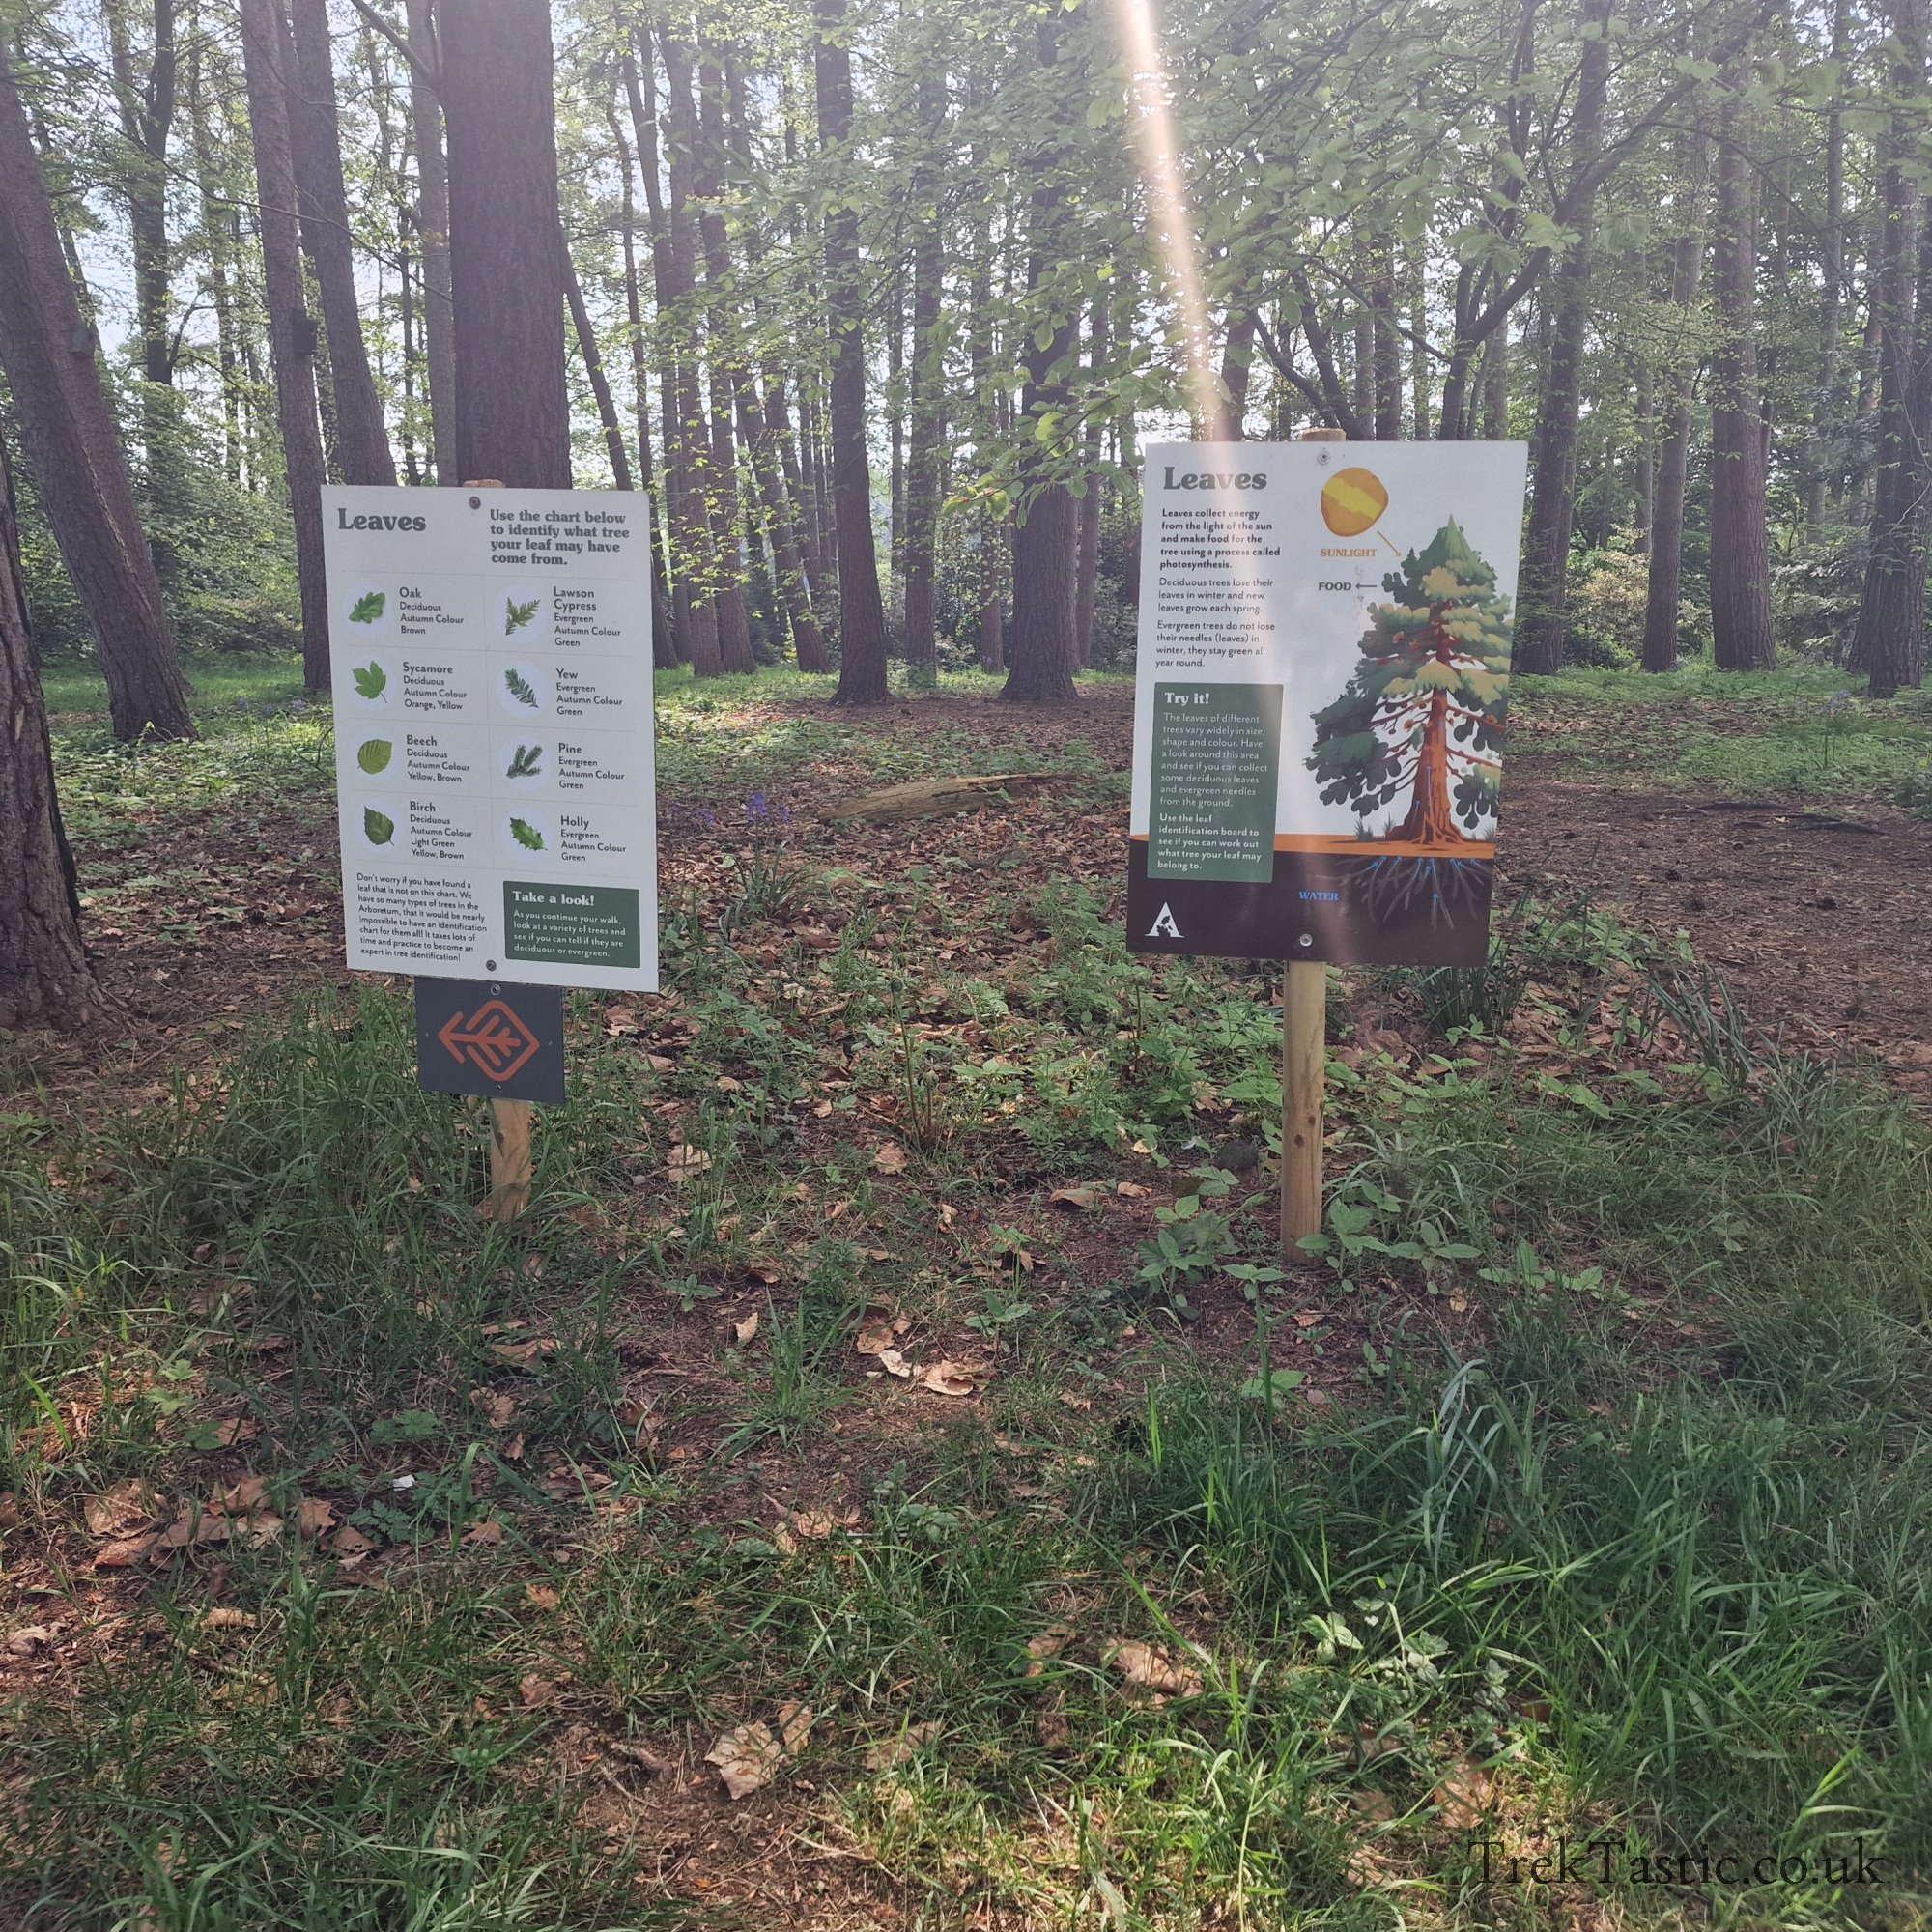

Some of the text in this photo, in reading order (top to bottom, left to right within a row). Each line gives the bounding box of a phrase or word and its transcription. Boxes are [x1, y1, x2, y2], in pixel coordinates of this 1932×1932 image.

[1163, 467, 1267, 490] Leaves
[337, 508, 426, 531] Leaves
[490, 509, 626, 524] Use the chart below
[1162, 508, 1260, 521] Leaves collect energy
[490, 524, 629, 540] to identify what tree
[491, 538, 620, 554] your leaf may have
[1180, 547, 1206, 558] using
[1215, 550, 1250, 558] process
[1252, 547, 1280, 555] called
[1321, 549, 1377, 557] SUNLIGHT
[491, 553, 567, 565] come from.
[1159, 559, 1232, 571] photosynthesis.
[1159, 577, 1207, 586] Deciduous
[1233, 578, 1250, 586] lose
[1253, 578, 1273, 587] their
[1319, 582, 1351, 591] FOOD
[399, 586, 421, 598] Oak
[554, 585, 594, 598] Lawson
[1159, 590, 1184, 599] leaves
[1227, 590, 1244, 599] and
[400, 601, 441, 611] Deciduous
[554, 598, 597, 612] Cypress
[400, 613, 464, 623] Autumn Colour
[554, 612, 593, 624] Evergreen
[401, 625, 426, 634] Brown
[554, 625, 621, 636] Autumn Colour
[1157, 620, 1200, 632] Evergreen
[1226, 621, 1237, 630] do
[554, 638, 580, 646] Green
[1157, 633, 1177, 641] their
[1179, 633, 1212, 641] needles
[1215, 633, 1248, 643] (leaves)
[403, 661, 453, 675] Sycamore
[1155, 658, 1205, 668] year round.
[555, 668, 578, 679] Yew
[403, 675, 444, 686] Deciduous
[404, 687, 467, 697] Autumn Colour
[556, 682, 595, 694] Evergreen
[404, 698, 463, 710] Orange, Yellow
[556, 695, 622, 705] Autumn Colour
[1165, 692, 1209, 706] Try it!
[556, 705, 582, 716] Green
[1163, 712, 1260, 723] The leaves of different
[407, 734, 437, 746] Beech
[407, 748, 448, 758] Deciduous
[558, 742, 582, 753] Pine
[408, 759, 469, 771] Autumn Colour
[558, 756, 597, 768] Evergreen
[408, 771, 462, 782] Yellow, Brown
[558, 768, 624, 780] Autumn Colour
[1186, 773, 1231, 782] deciduous
[1234, 774, 1259, 783] leaves
[559, 780, 583, 789] Green
[1160, 784, 1256, 796] and evergreen needles
[410, 801, 436, 812] Birch
[1160, 796, 1232, 809] from the ground.
[410, 813, 450, 825] Deciduous
[560, 815, 589, 830] Holly
[1159, 812, 1212, 823] Use the leaf
[411, 826, 472, 838] Autumn Colour
[560, 829, 599, 840] Evergreen
[1159, 825, 1218, 835] identification
[1221, 827, 1247, 836] board
[411, 837, 455, 847] Light Green
[561, 840, 626, 852] Autumn Colour
[411, 848, 464, 859] Yellow, Brown
[561, 852, 585, 862] Green
[1157, 848, 1179, 857] what
[1202, 852, 1222, 861] your
[1224, 850, 1240, 859] leaf
[1242, 854, 1261, 863] may
[1157, 860, 1187, 871] belong
[512, 891, 544, 902] Take
[561, 894, 594, 906] look!
[1299, 891, 1338, 900] WATER
[358, 904, 401, 916] Arboretum,
[426, 910, 449, 919] would
[451, 911, 460, 920] be
[462, 913, 485, 923] nearly
[513, 909, 524, 918] As
[542, 913, 578, 922] continue
[600, 916, 621, 924] walk,
[359, 916, 398, 925] impossible
[409, 919, 425, 927] have
[438, 921, 487, 931] identification
[410, 951, 460, 961] identification!
[514, 943, 555, 953] deciduous
[568, 950, 610, 958] evergreen.
